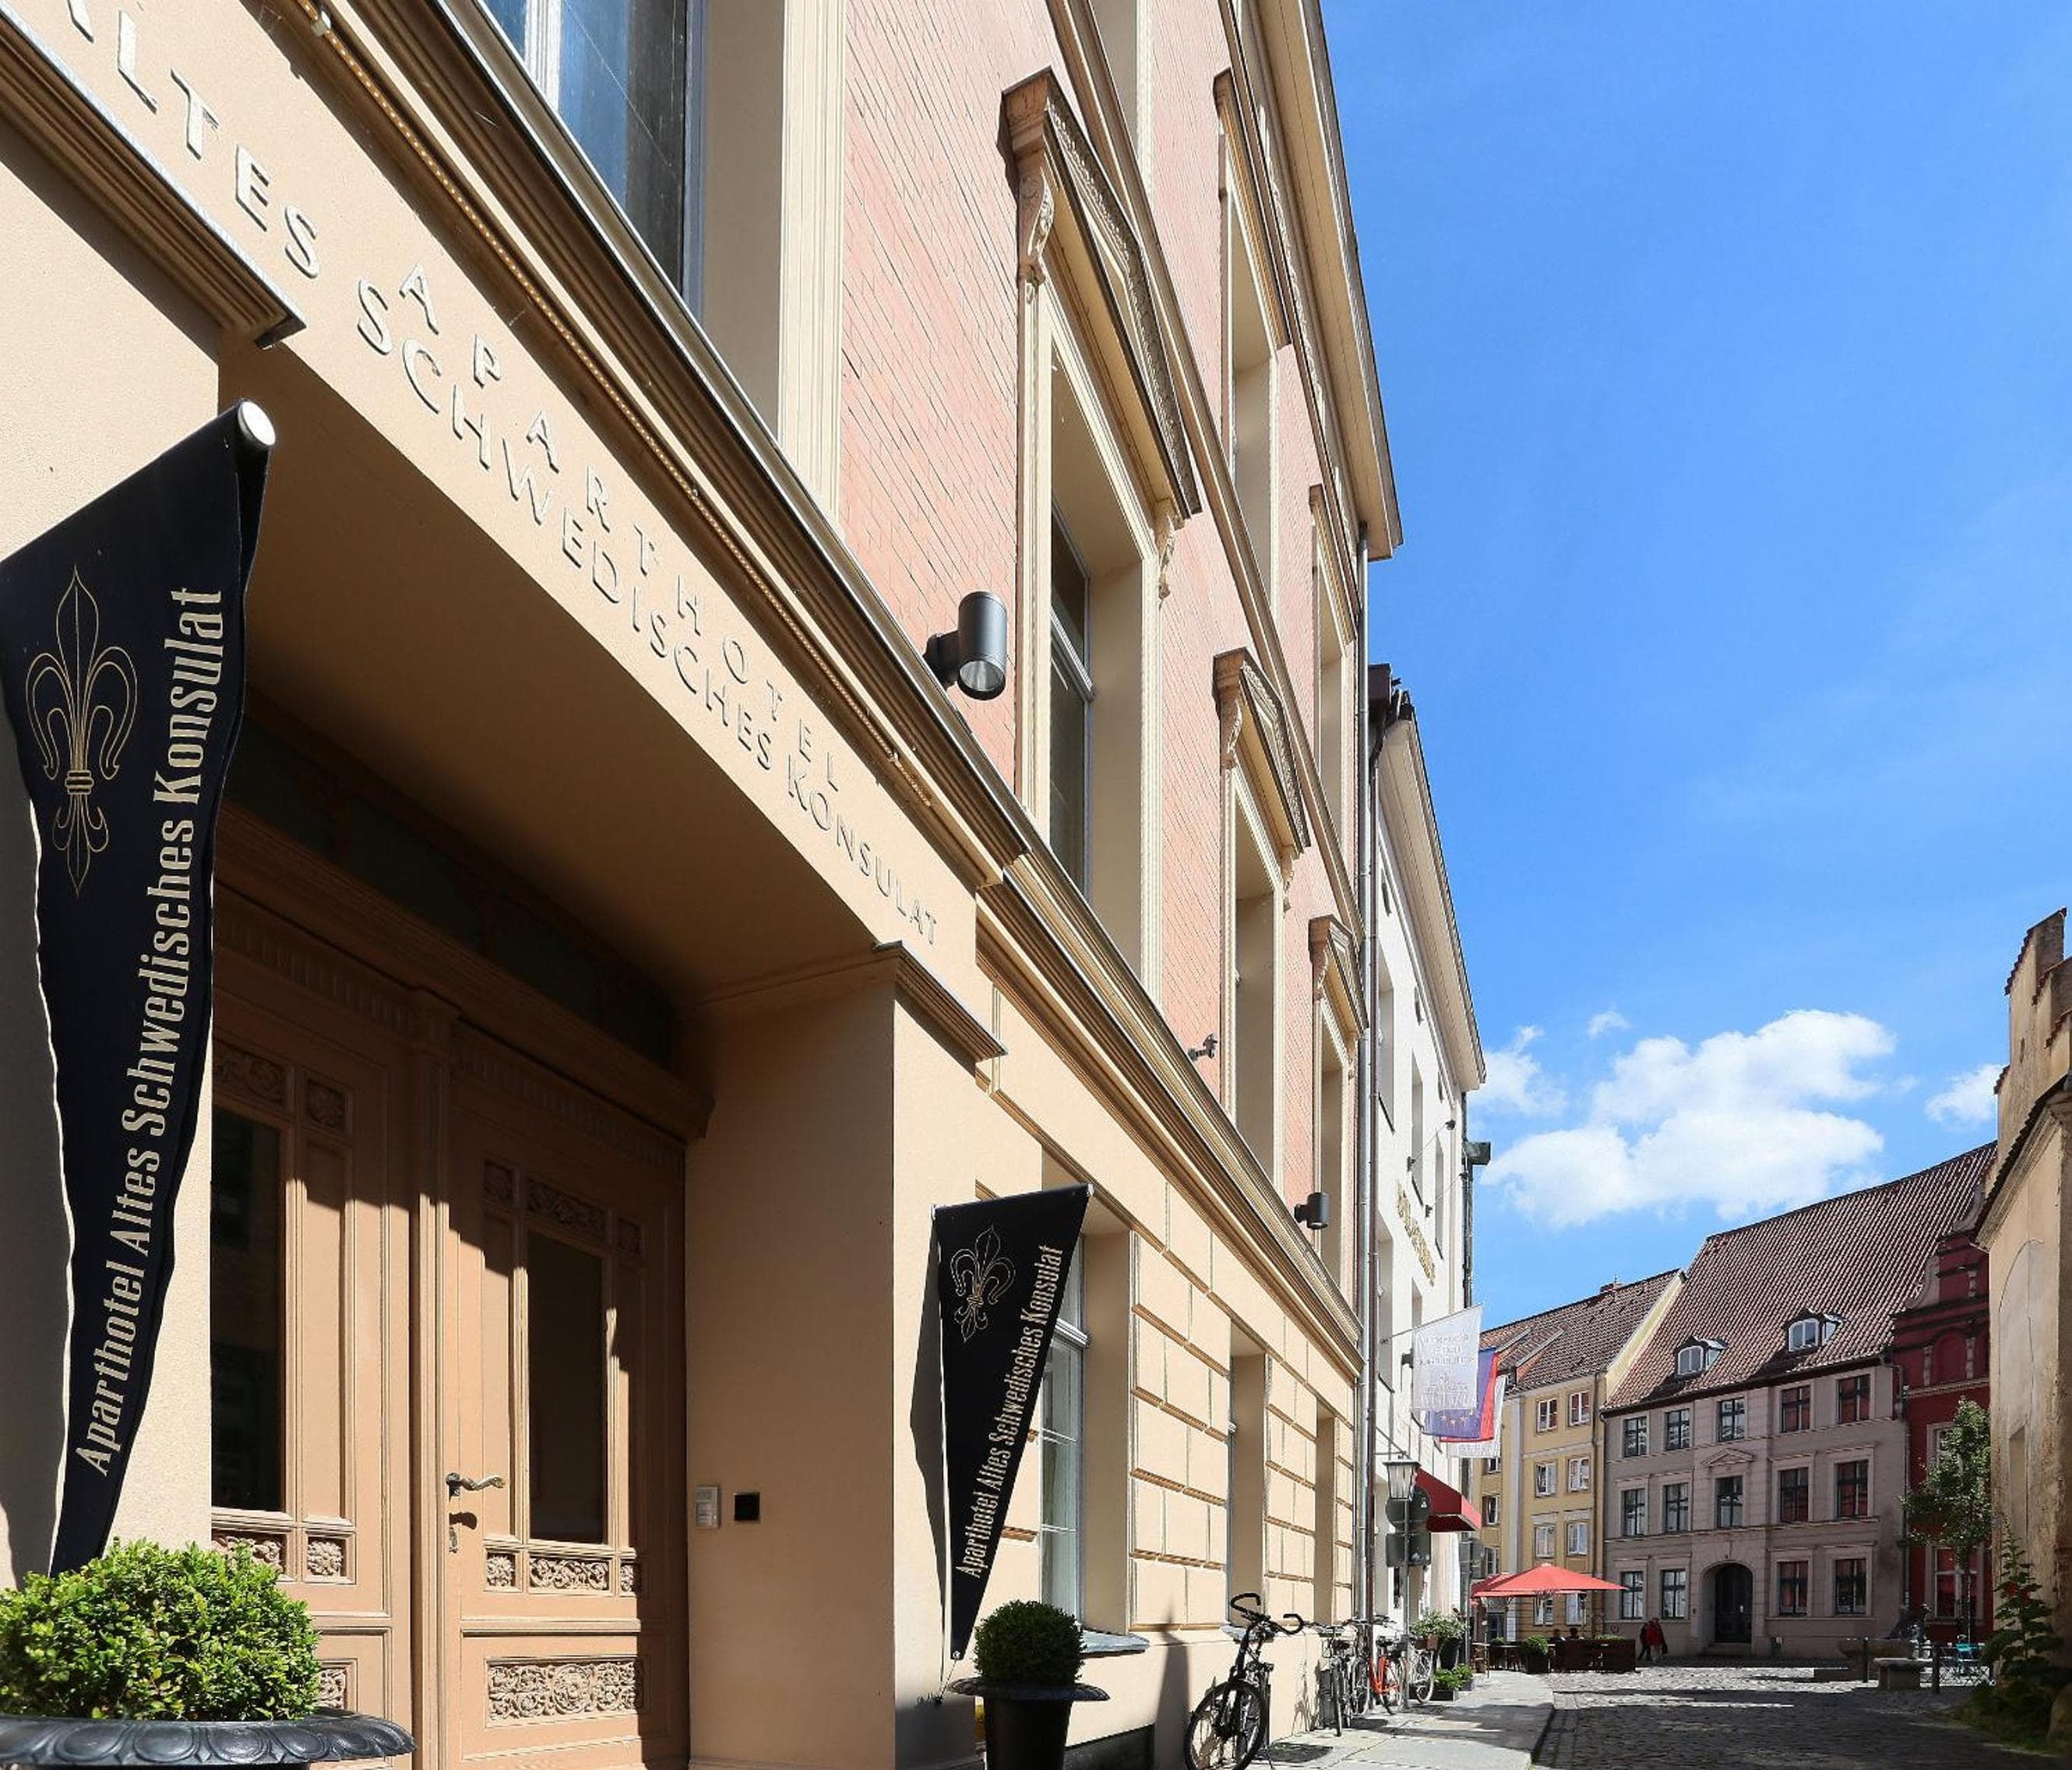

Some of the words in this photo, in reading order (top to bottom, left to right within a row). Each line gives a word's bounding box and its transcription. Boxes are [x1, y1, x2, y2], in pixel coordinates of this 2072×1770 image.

[67, 0, 319, 279] LTES
[356, 278, 772, 770] SCHWEDISCHES
[788, 753, 937, 946] KONSULAT
[153, 587, 224, 805] Konsulat
[121, 820, 194, 1137] Schwedisches
[110, 1147, 160, 1257] Altes
[1020, 1244, 1062, 1325] Konsulat
[75, 1259, 146, 1476] Aparthotel
[988, 1327, 1045, 1446] Schwedisches
[975, 1447, 1012, 1492] Altes
[956, 1490, 998, 1578] Aparthotel
